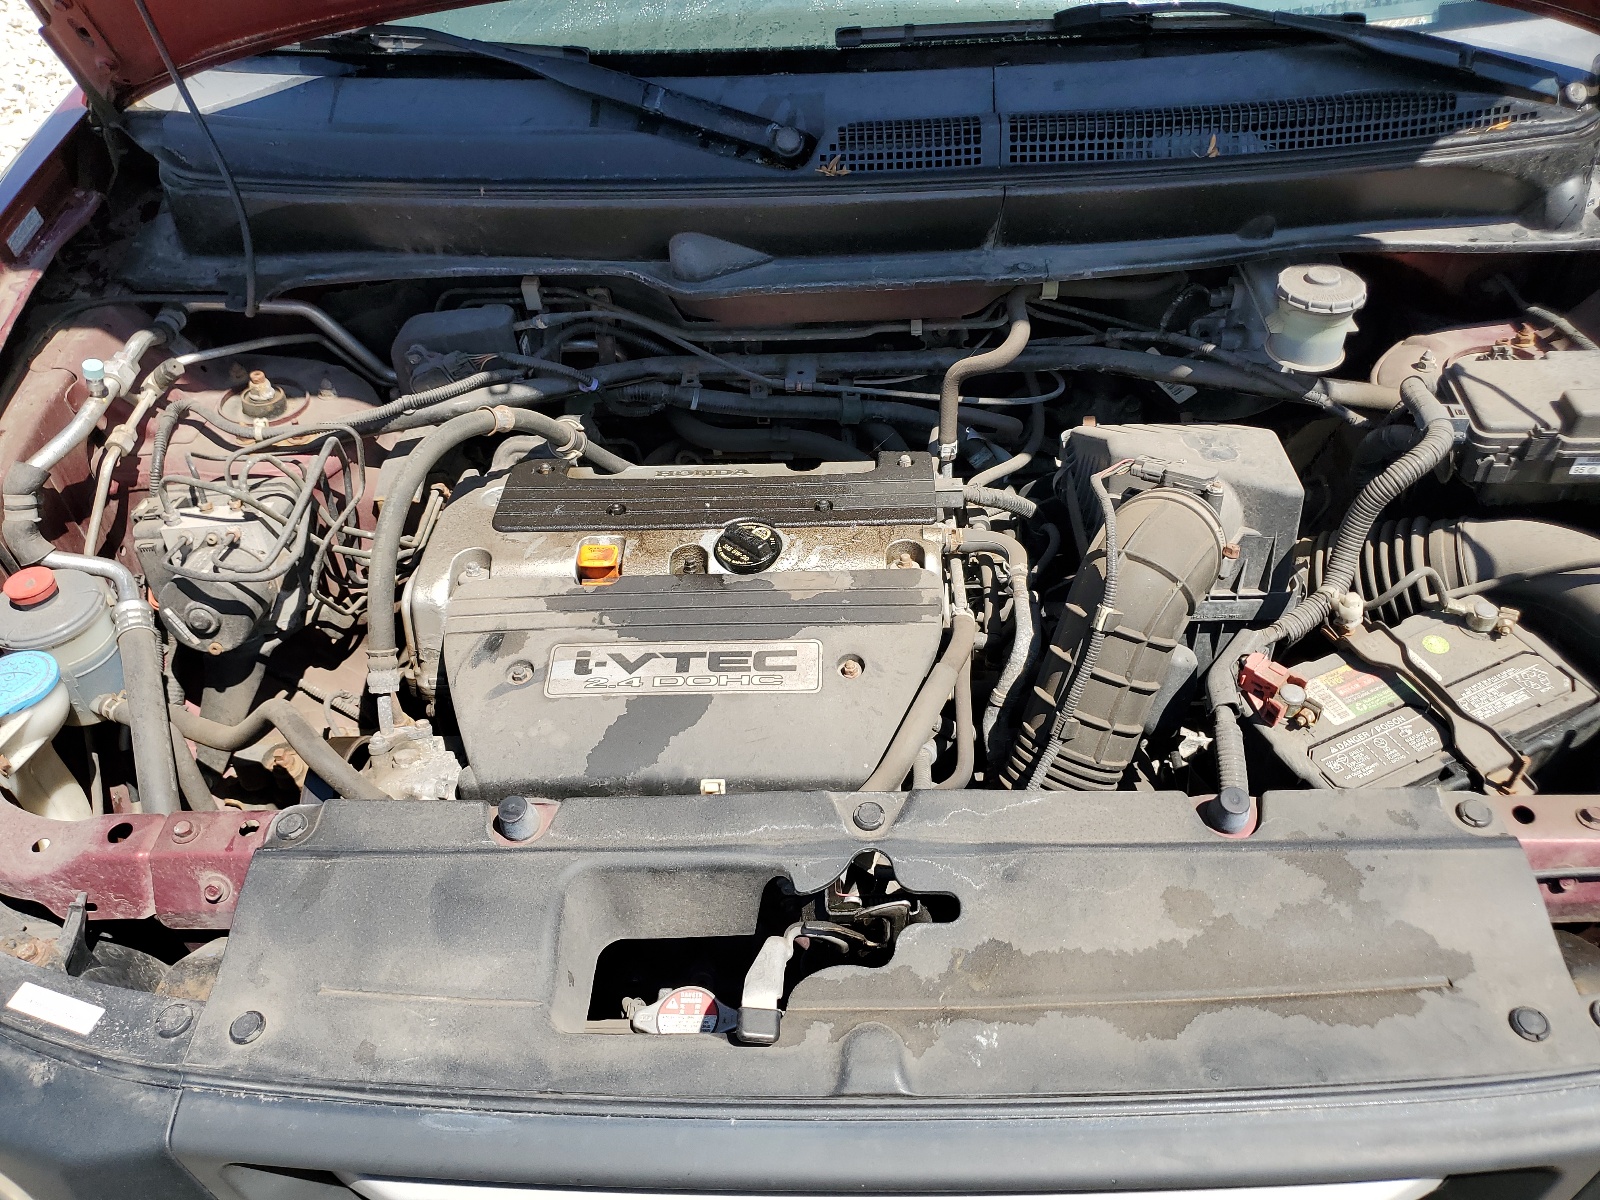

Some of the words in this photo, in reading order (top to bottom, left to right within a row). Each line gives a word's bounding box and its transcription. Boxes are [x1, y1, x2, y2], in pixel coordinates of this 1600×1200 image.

[654, 469, 752, 477] HONDA
[574, 650, 797, 676] i-VTEC
[584, 676, 643, 689] 2.4
[652, 674, 783, 688] DOHC
[1335, 731, 1371, 750] DANGER
[1374, 715, 1406, 733] POISON
